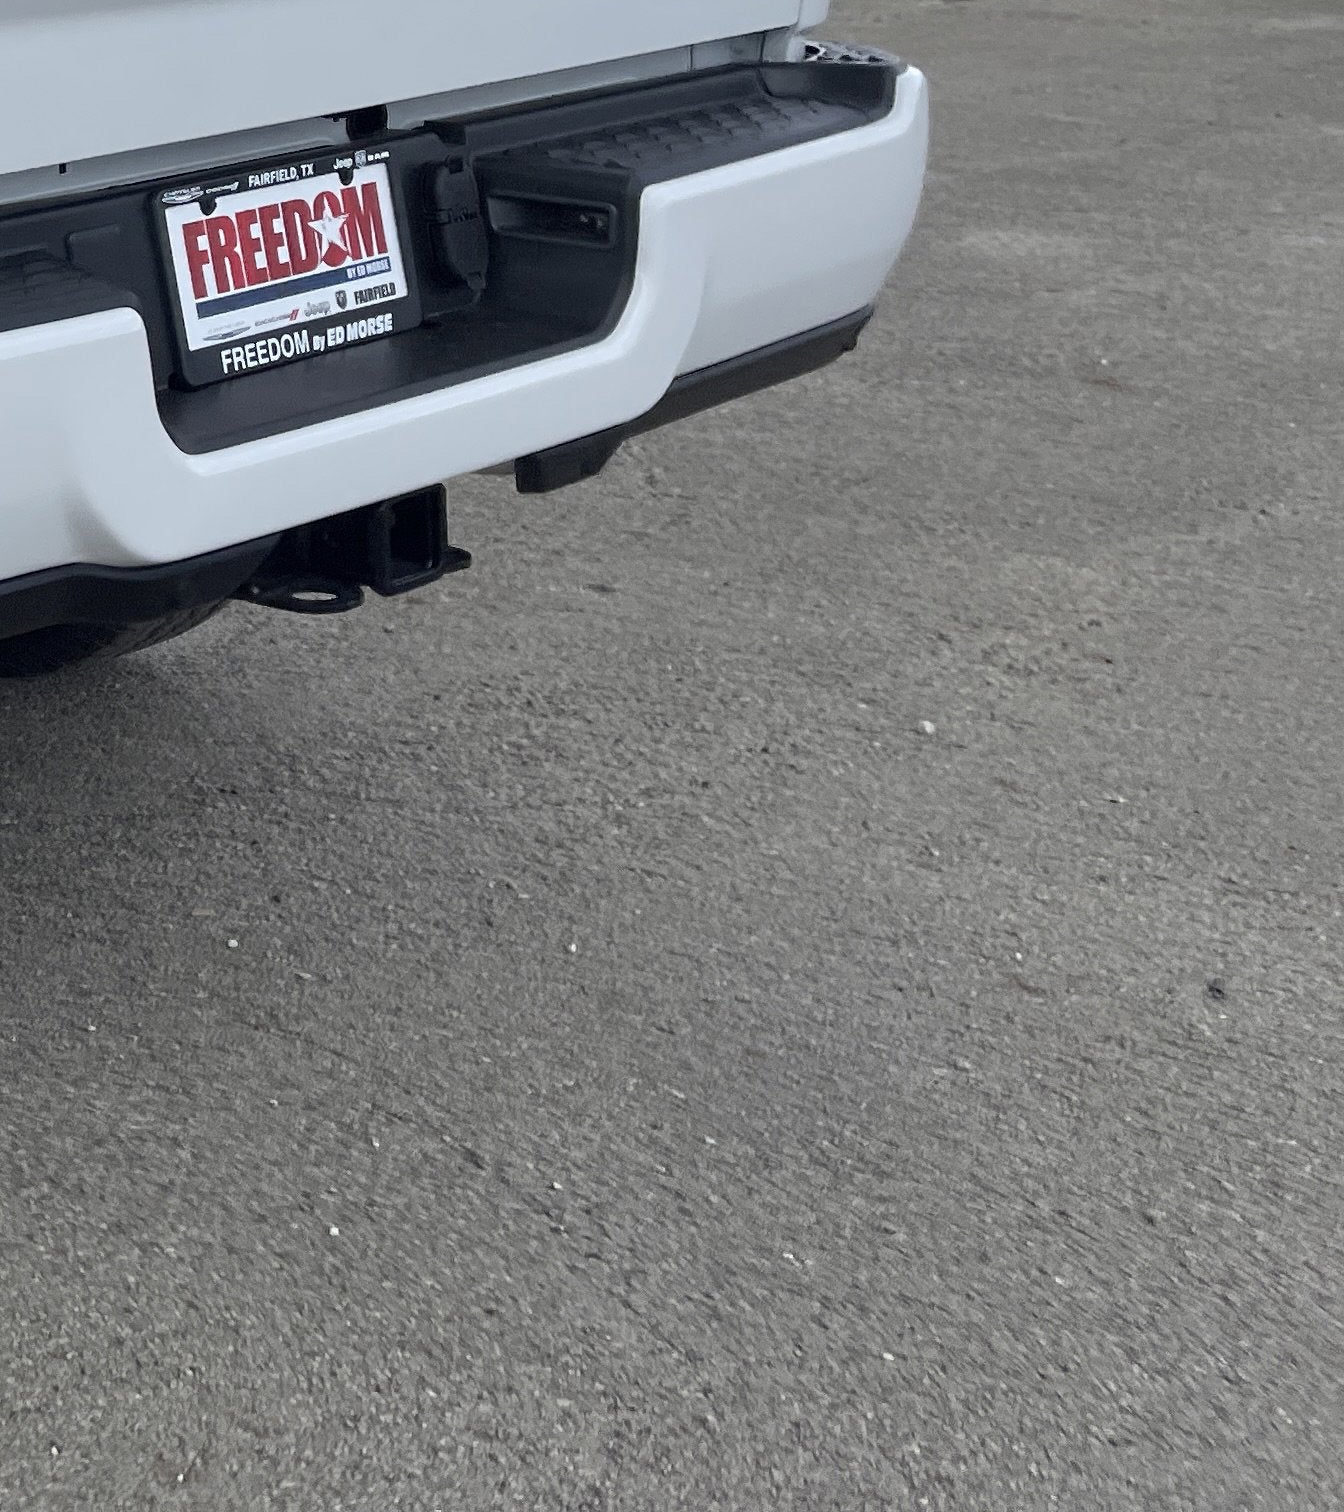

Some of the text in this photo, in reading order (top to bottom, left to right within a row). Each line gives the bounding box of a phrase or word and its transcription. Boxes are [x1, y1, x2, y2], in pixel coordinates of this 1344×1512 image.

[248, 163, 315, 188] FAIRFIELD, TX
[182, 182, 388, 300] FREEDOM
[354, 282, 396, 305] FAIRFIELD
[221, 330, 310, 374] FREEDOM
[326, 327, 345, 347] ED
[346, 313, 393, 343] MORSE
